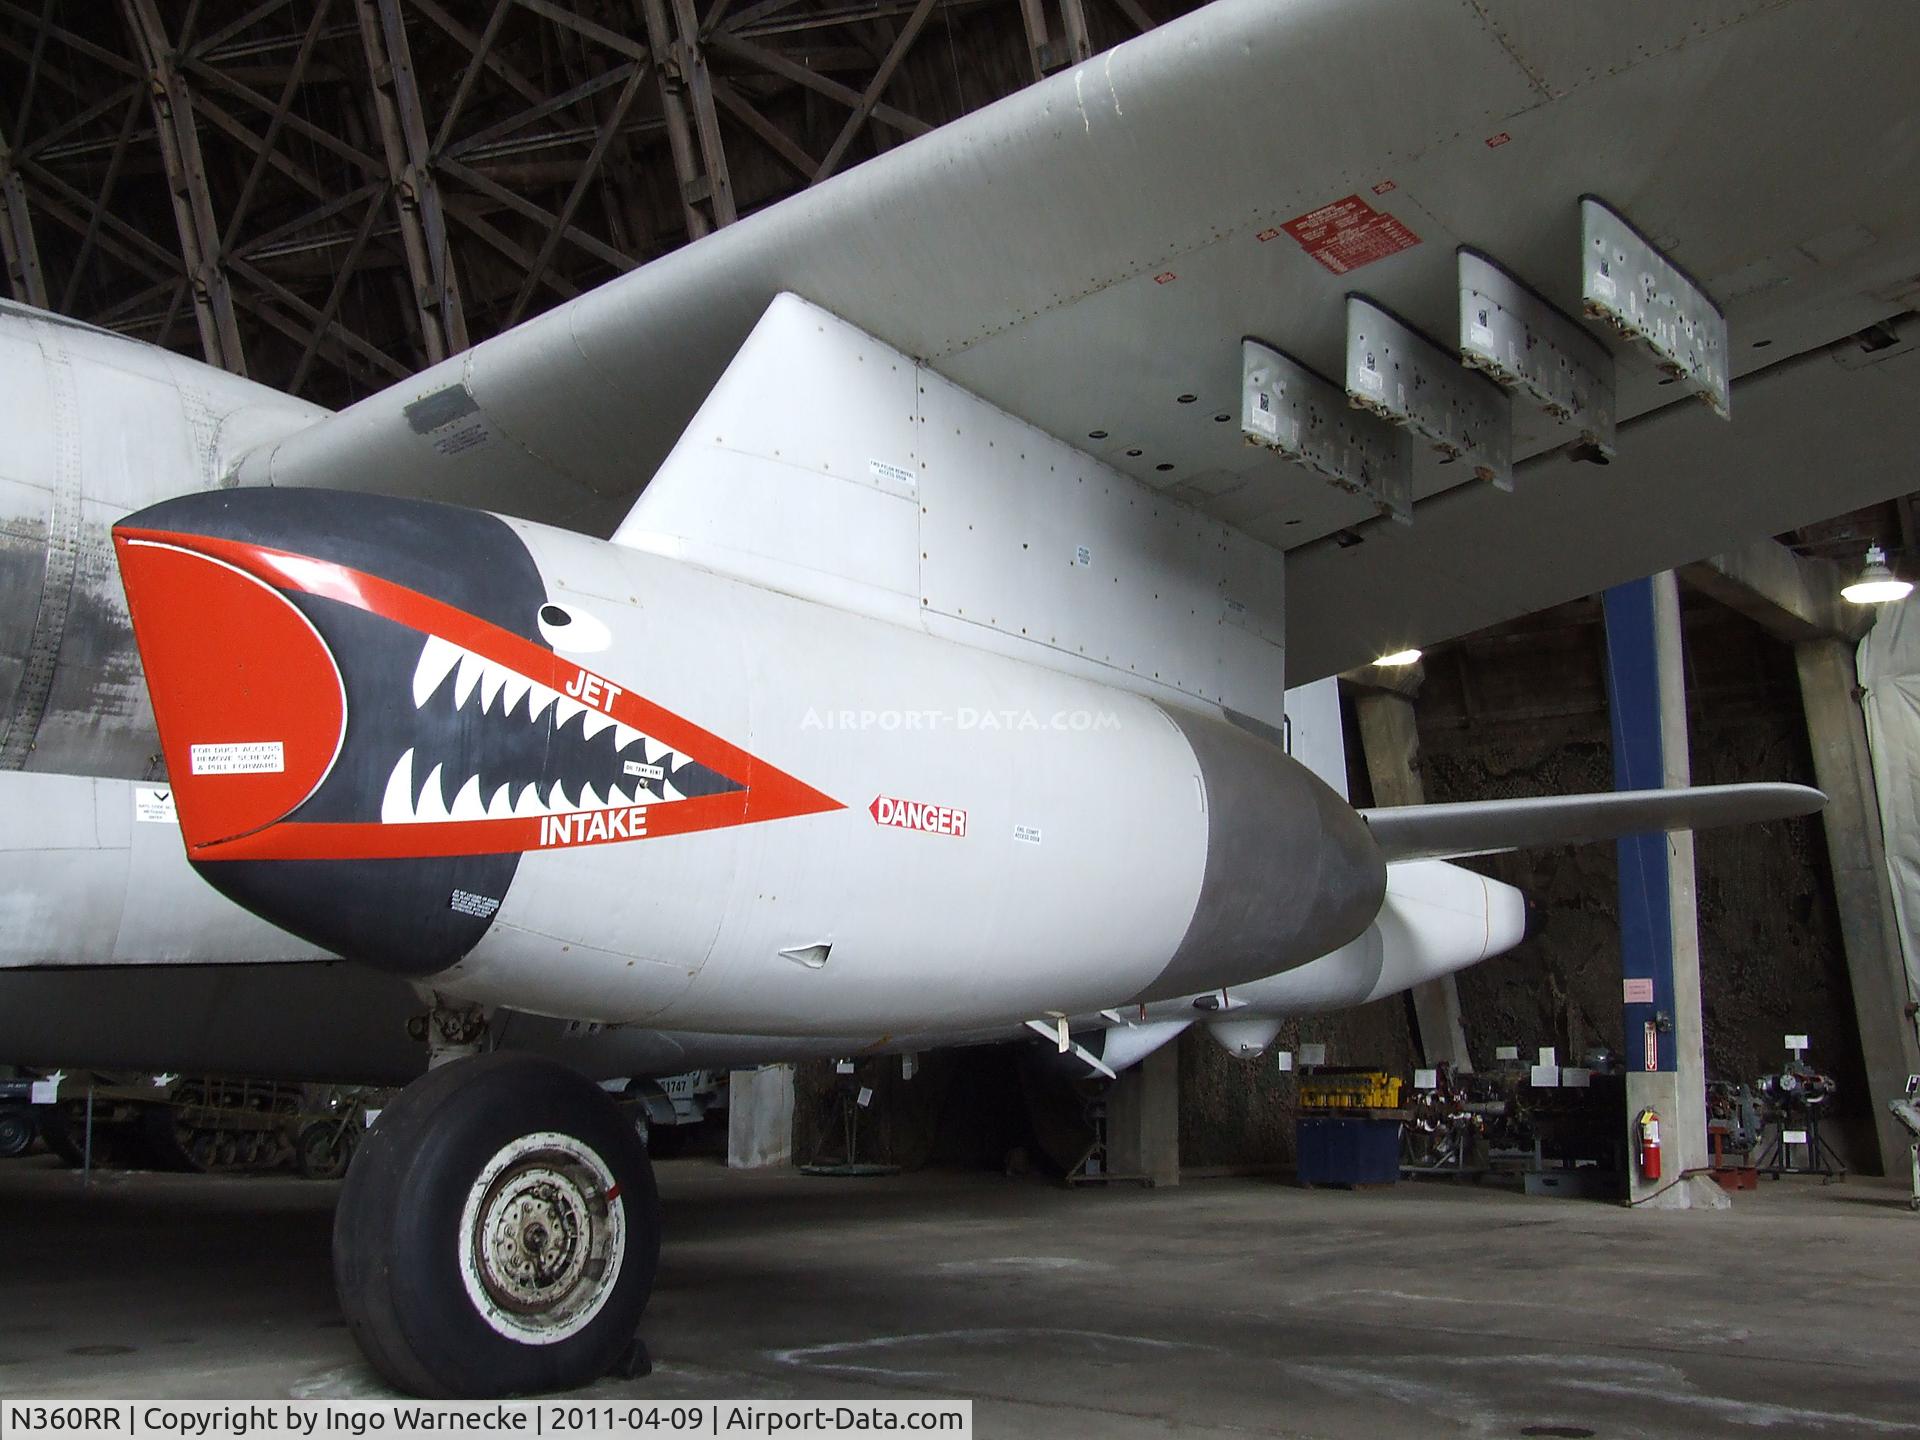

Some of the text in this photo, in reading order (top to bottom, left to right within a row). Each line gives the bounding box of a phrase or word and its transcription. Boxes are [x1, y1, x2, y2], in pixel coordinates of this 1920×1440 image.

[565, 670, 622, 713] JET
[196, 754, 278, 763] REMOVE SCREWS
[214, 746, 238, 754] DUCT
[243, 745, 281, 753] ACCESS
[539, 806, 648, 847] INTAKE
[877, 797, 966, 837] DANGER
